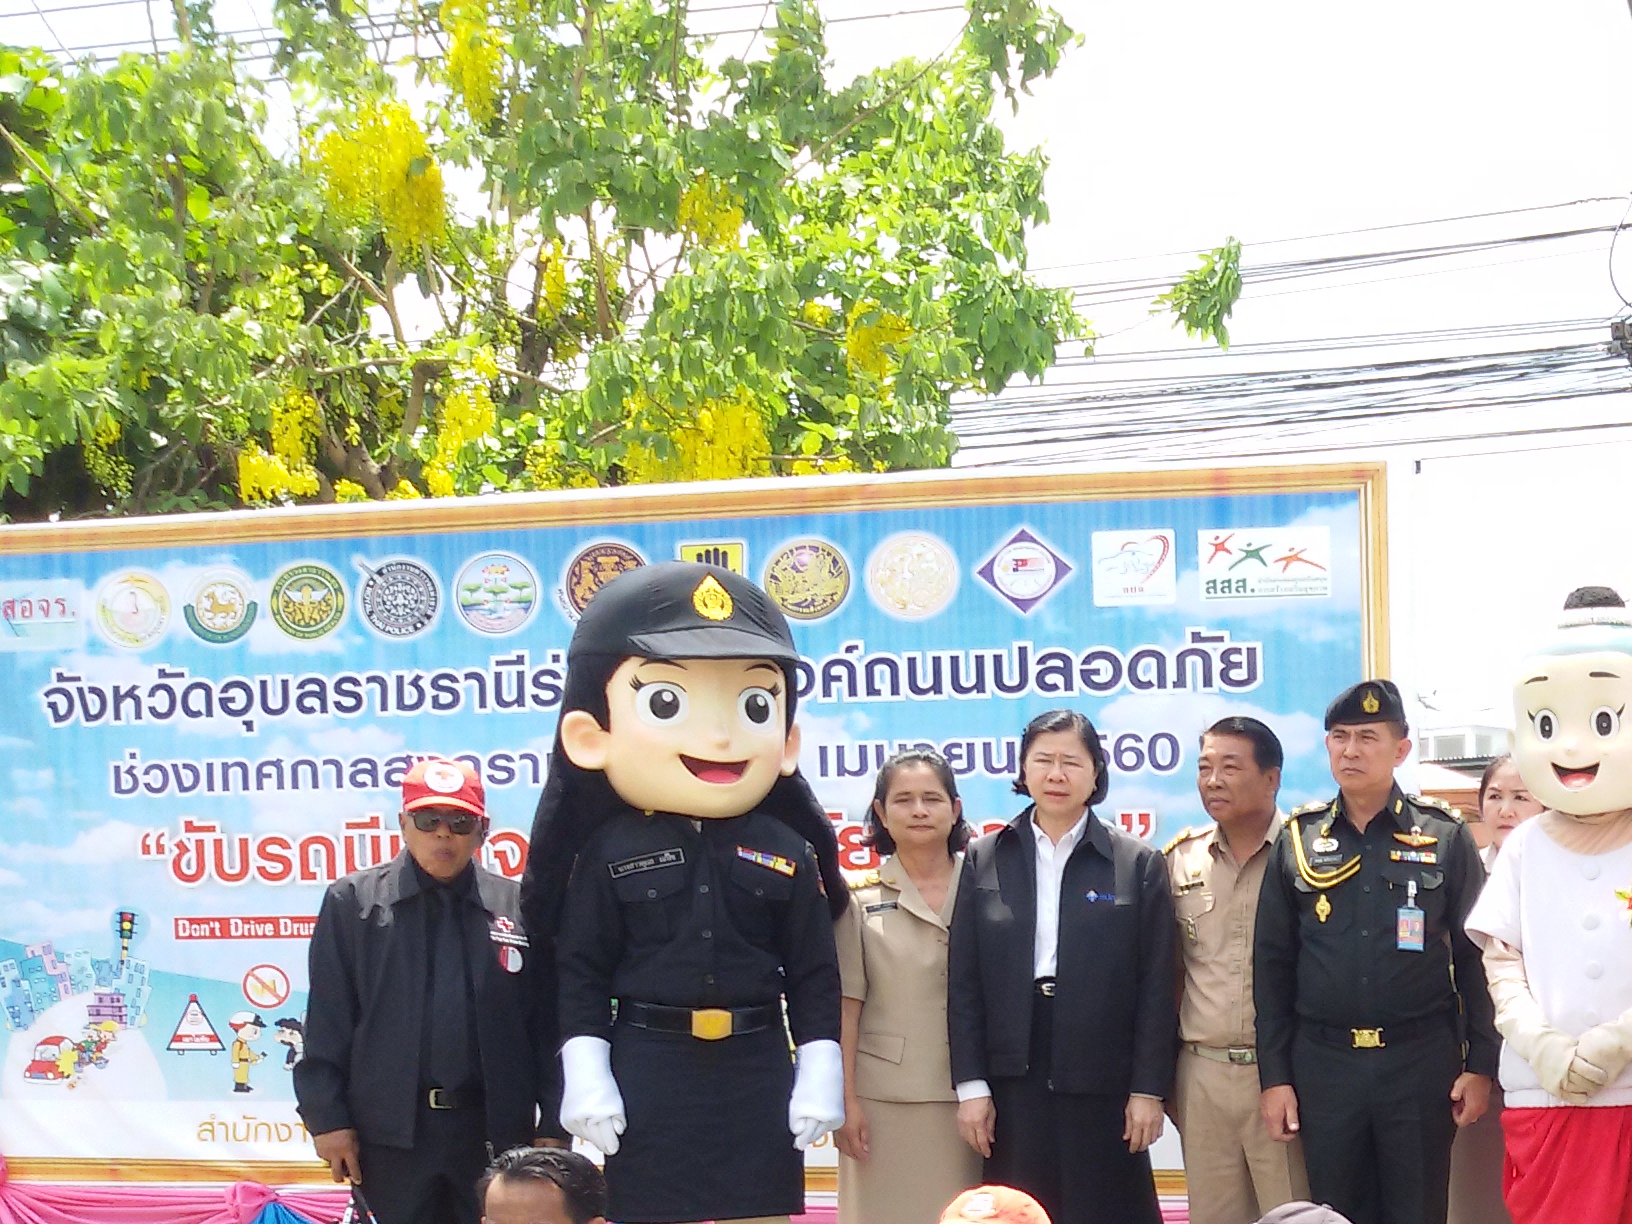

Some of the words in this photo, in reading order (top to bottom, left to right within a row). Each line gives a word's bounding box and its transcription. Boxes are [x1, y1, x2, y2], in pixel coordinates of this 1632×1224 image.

[1205, 577, 1256, 595] สสส.
[178, 919, 221, 937] Don't
[229, 918, 275, 937] Drive
